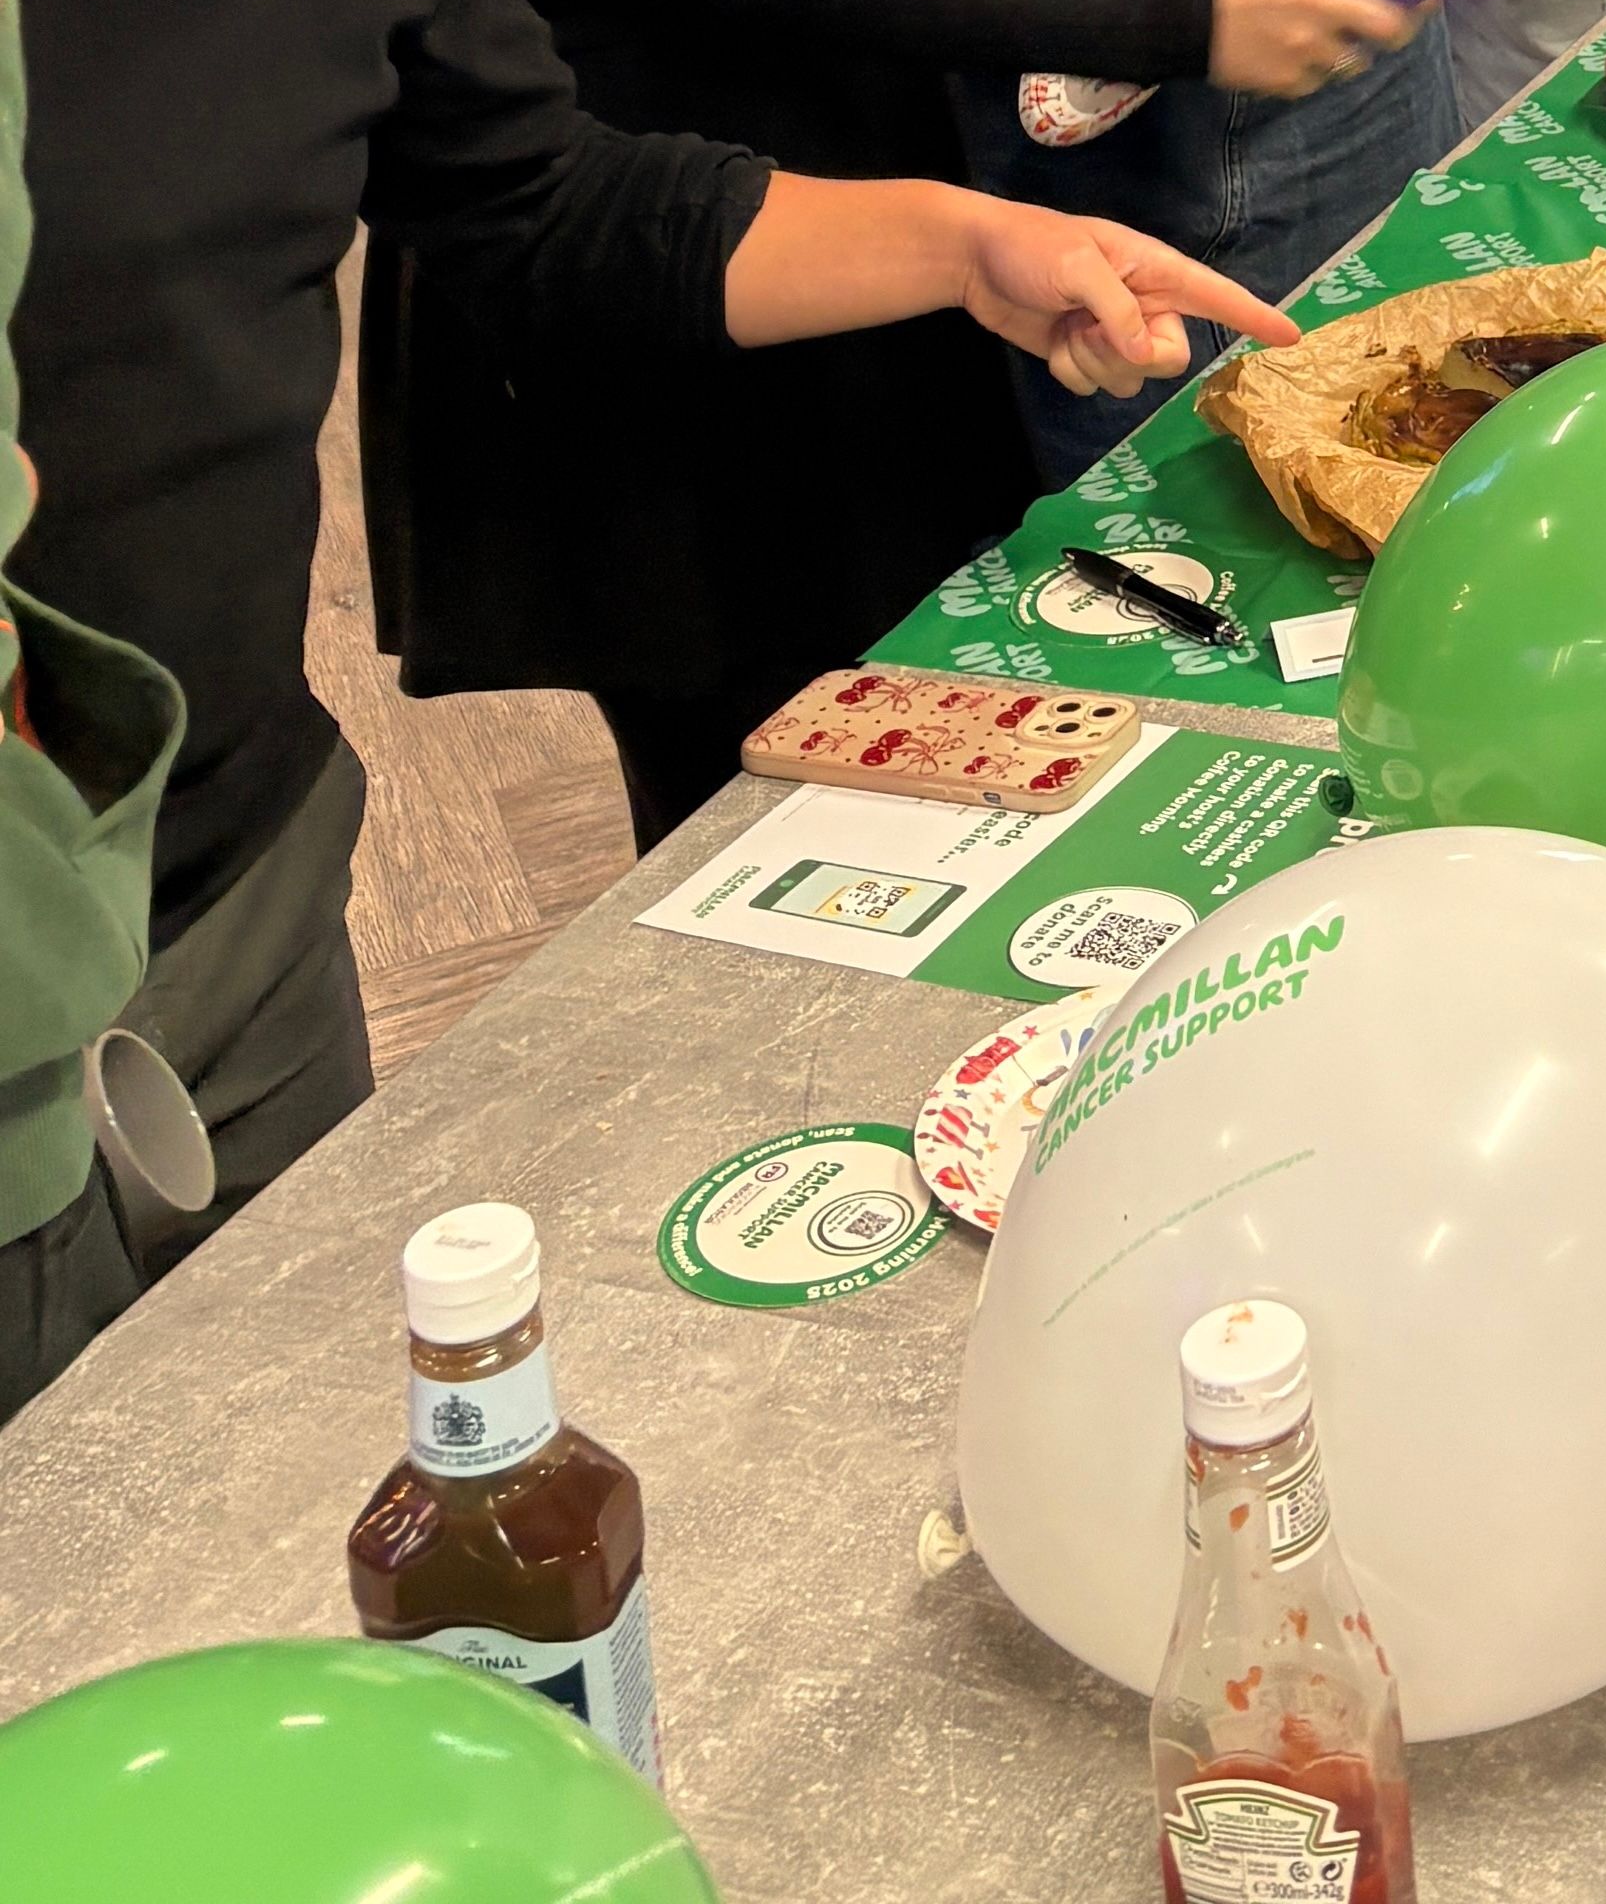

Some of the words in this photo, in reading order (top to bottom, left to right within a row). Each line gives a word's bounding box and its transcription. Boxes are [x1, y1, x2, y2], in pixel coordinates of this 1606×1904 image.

[1193, 750, 1242, 788] Coffee
[1244, 754, 1266, 769] to
[1293, 763, 1316, 777] to
[1216, 767, 1250, 796] your
[1231, 758, 1290, 810] donation
[1260, 778, 1298, 810] make
[1178, 795, 1226, 830] host's
[1280, 796, 1313, 819] this
[1182, 808, 1238, 856] directly
[1199, 818, 1255, 868] cashless
[1259, 818, 1287, 839] QR
[1228, 838, 1266, 870] code
[1019, 902, 1077, 951] donate
[1049, 927, 1076, 950] me
[1028, 949, 1053, 967] to
[1036, 913, 1346, 1146] MACMILLAN
[1033, 1057, 1136, 1176] CANCER
[1140, 968, 1310, 1076] SUPPORT
[711, 1160, 743, 1185] and
[744, 1160, 846, 1250] MACMILLAN
[805, 1271, 871, 1301] 2025
